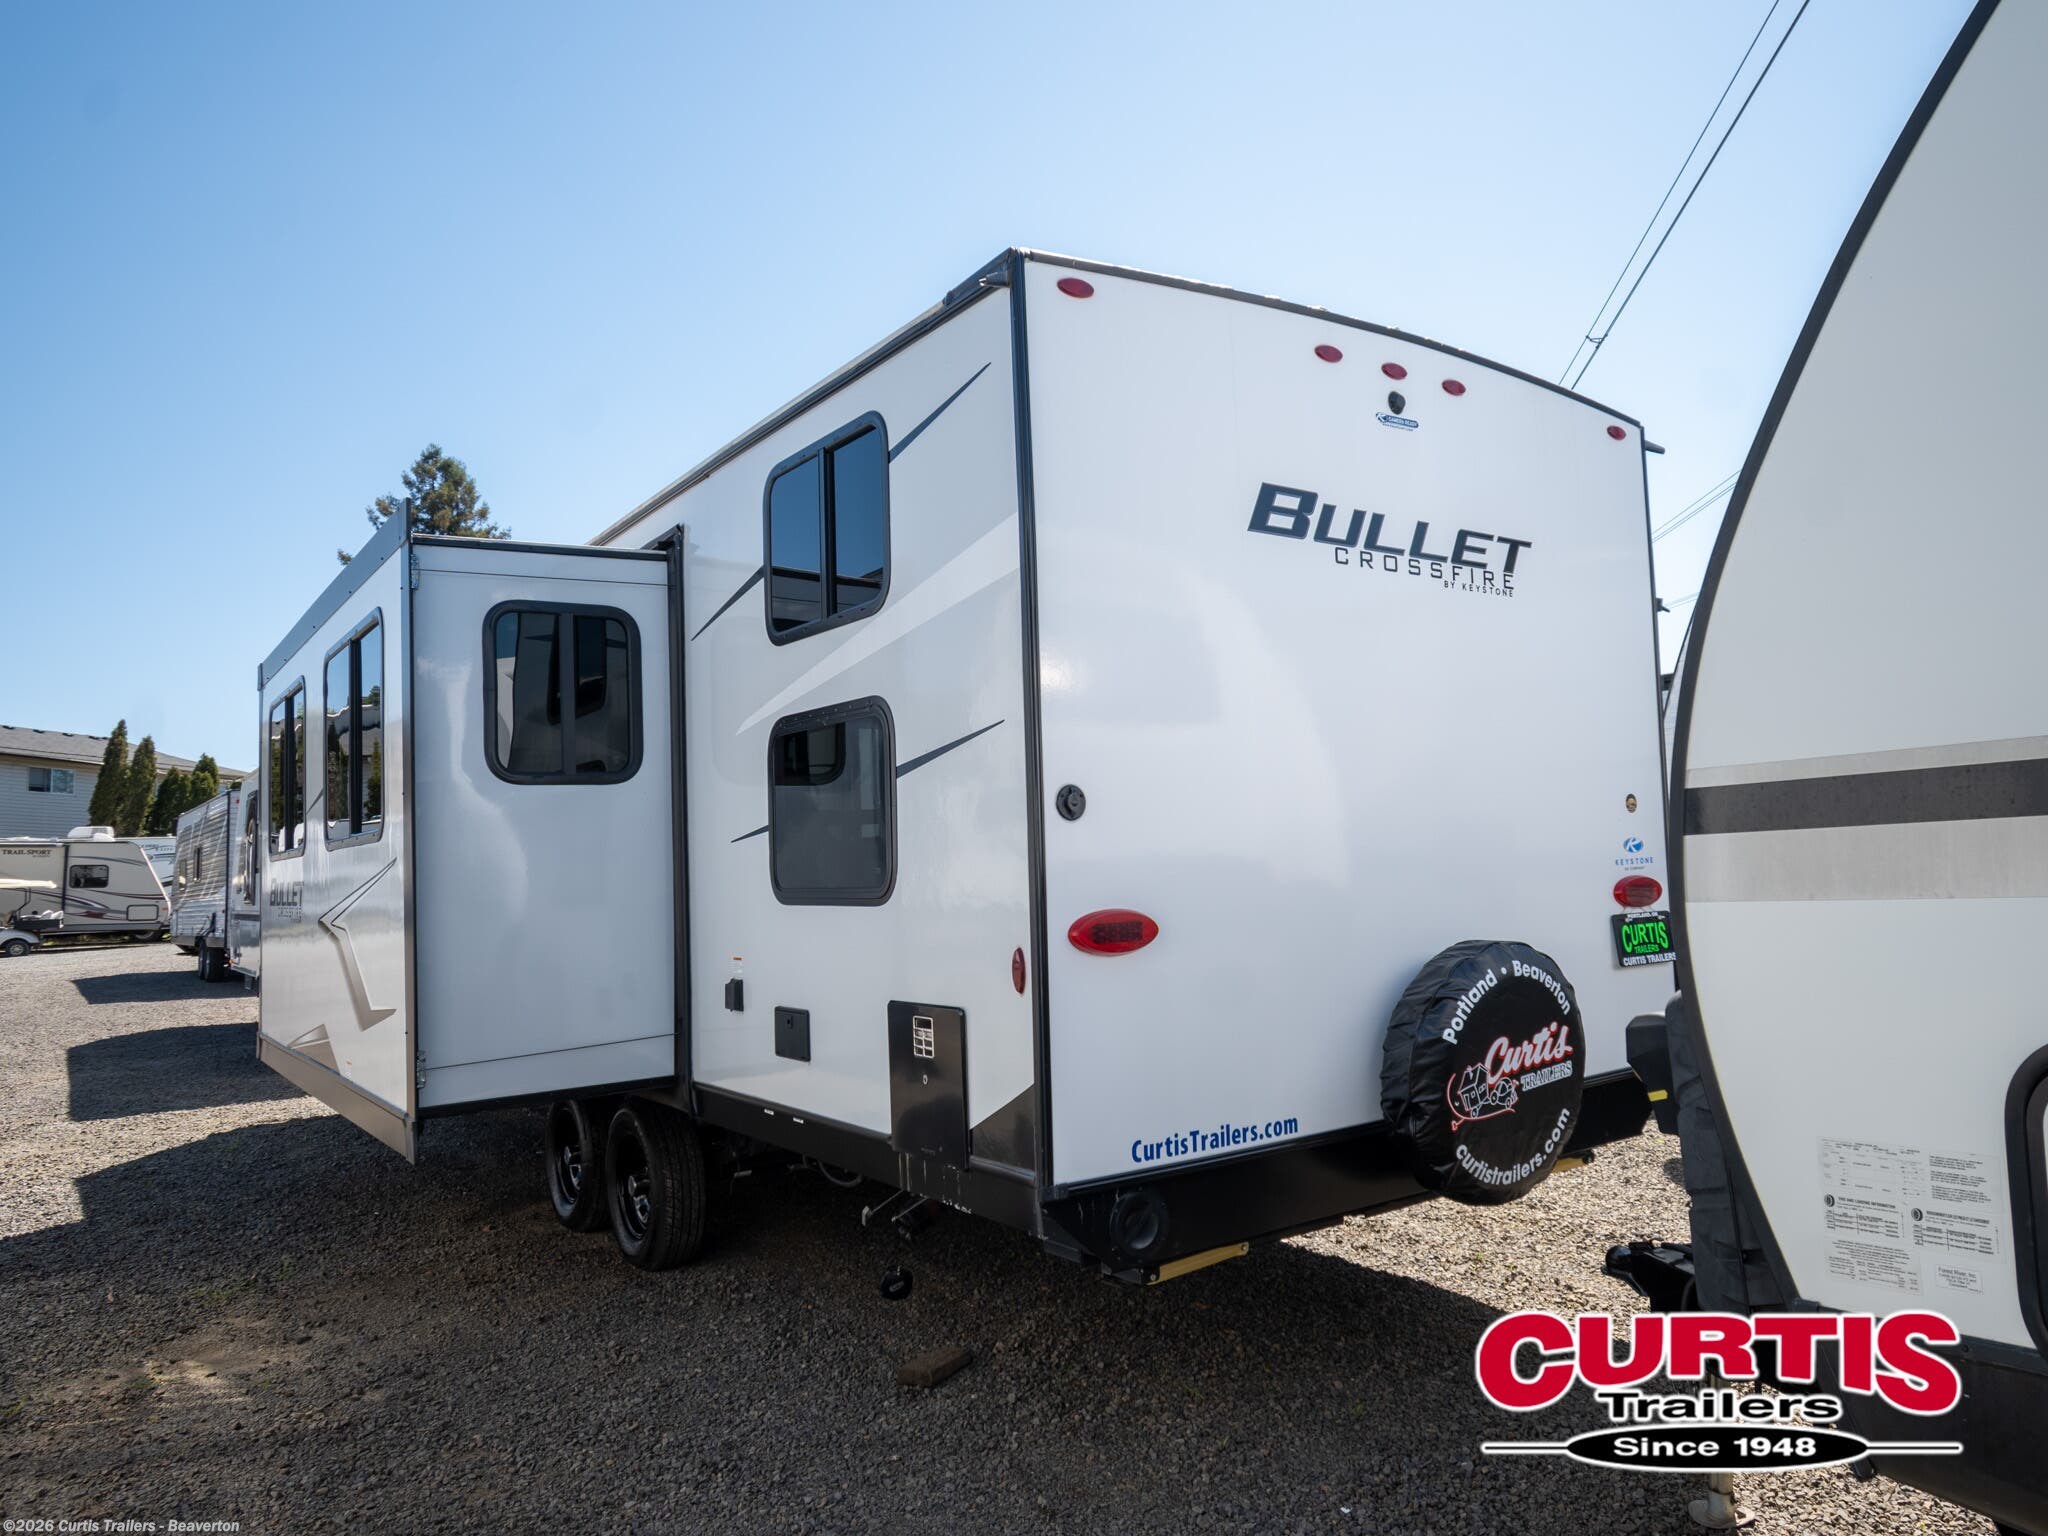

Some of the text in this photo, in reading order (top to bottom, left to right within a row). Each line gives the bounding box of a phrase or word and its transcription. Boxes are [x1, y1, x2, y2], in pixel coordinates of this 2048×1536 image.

[1247, 482, 1532, 573] BULLET
[1334, 547, 1514, 590] CROSSFIRE
[1443, 580, 1514, 598] BY KEYSTONE
[1615, 857, 1654, 866] KEYSTONE
[1622, 921, 1669, 953] CURTIS
[1623, 952, 1676, 966] CURTIS TRAILERS
[1442, 959, 1571, 1045] Portland Beaverton
[1484, 1021, 1573, 1087] Curtis
[1520, 1060, 1573, 1092] TRAILERS
[1131, 1117, 1298, 1163] CurtisTrailers.com
